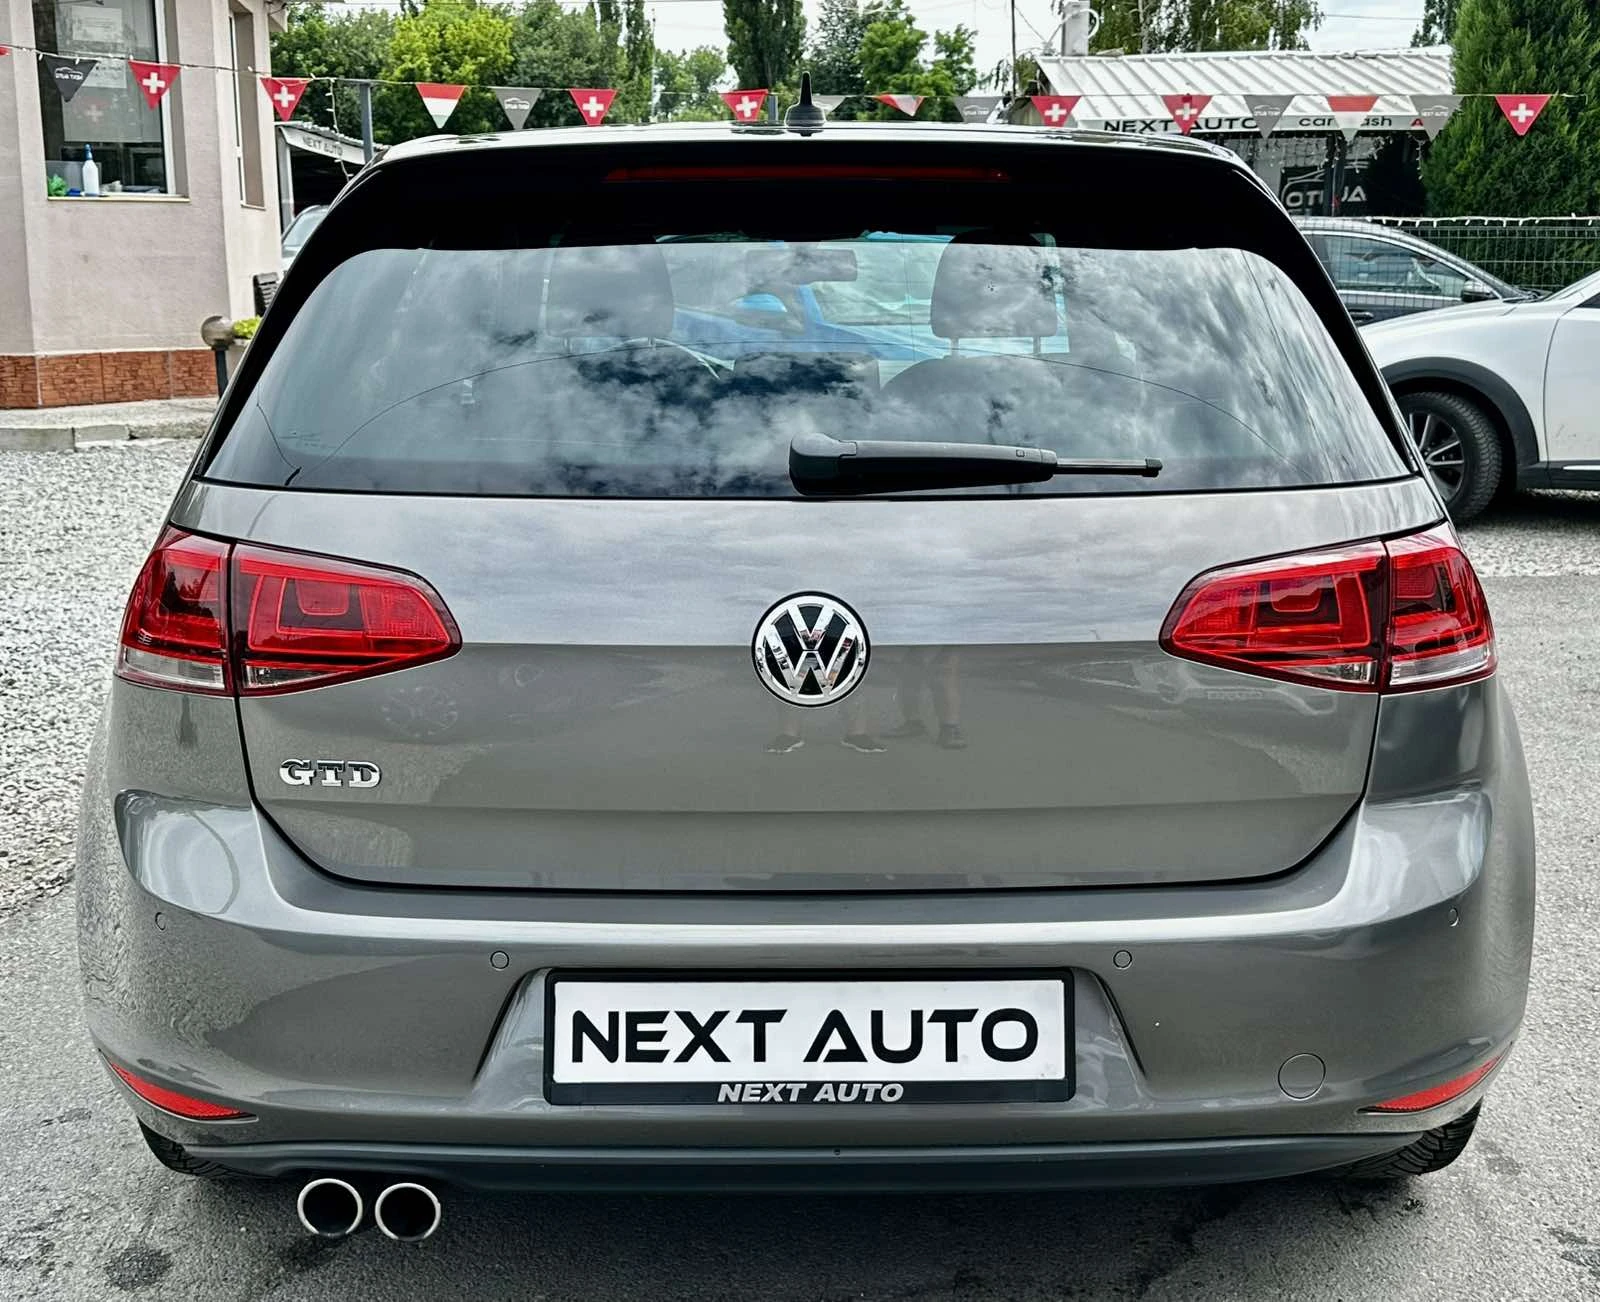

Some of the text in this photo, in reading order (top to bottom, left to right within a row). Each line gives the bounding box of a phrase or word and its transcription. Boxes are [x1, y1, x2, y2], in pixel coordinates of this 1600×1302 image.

[1104, 120, 1173, 133] NEXT
[1298, 116, 1393, 127] car ash
[279, 758, 382, 788] GTD
[572, 1007, 1039, 1064] NEXT AUTO
[717, 1083, 905, 1103] NEXT AUTO
